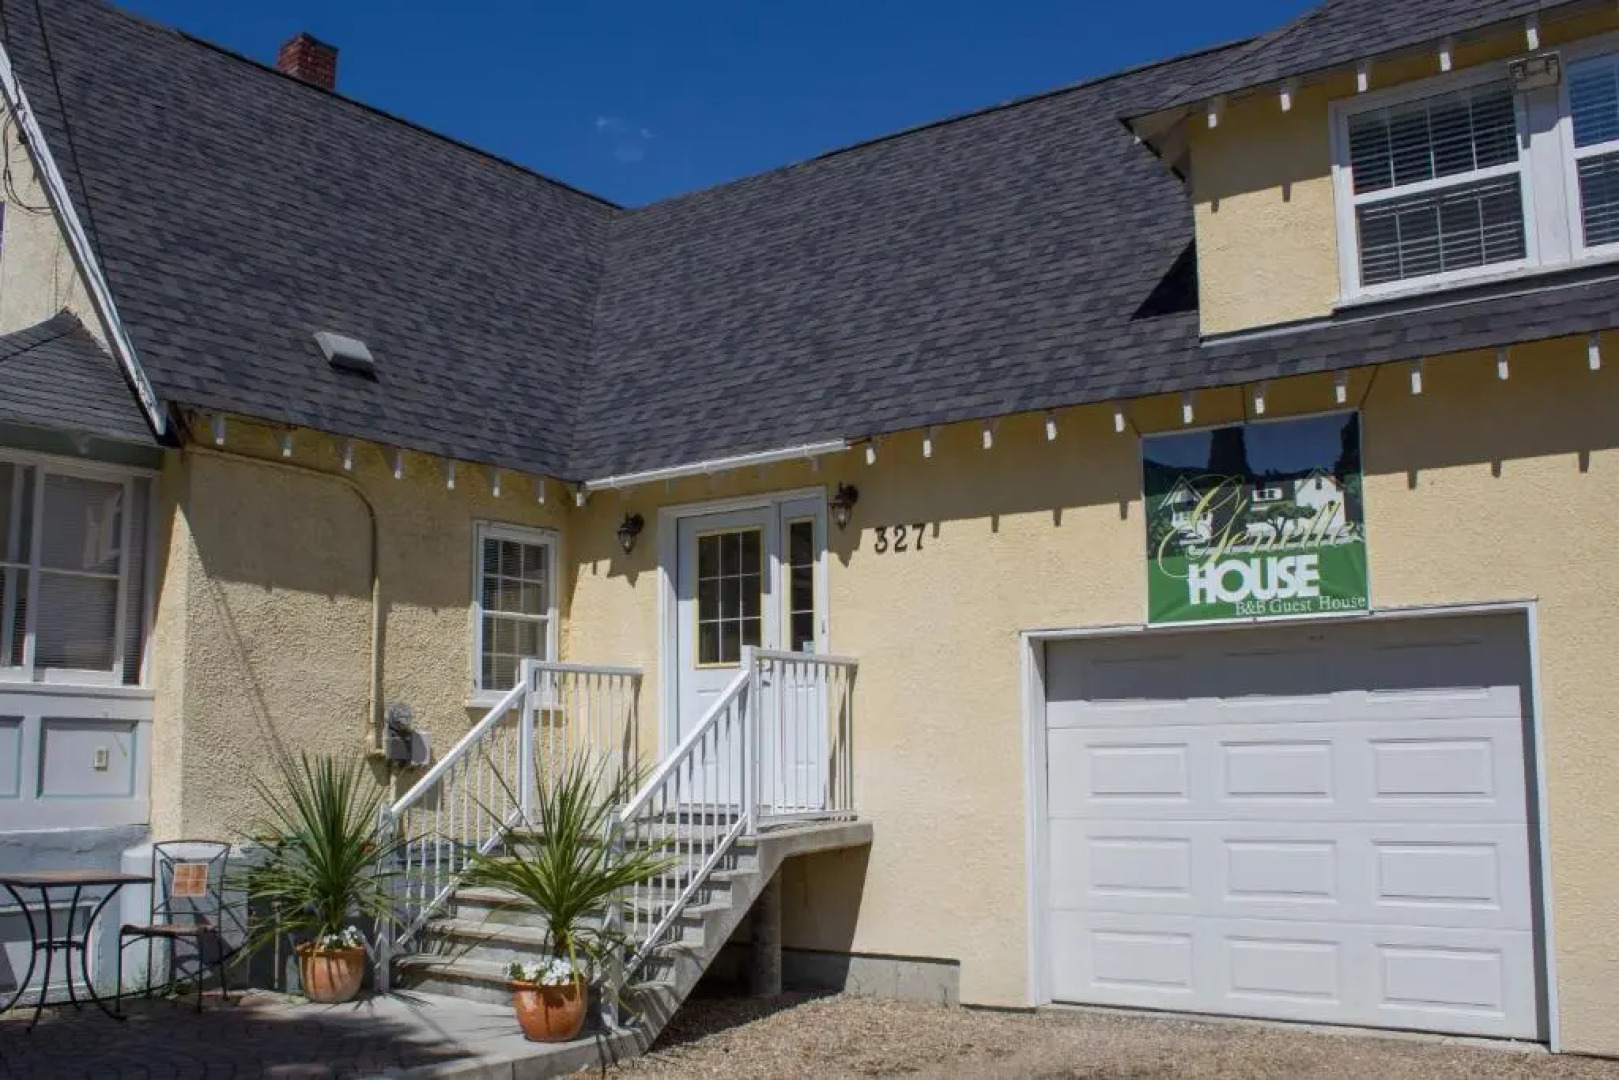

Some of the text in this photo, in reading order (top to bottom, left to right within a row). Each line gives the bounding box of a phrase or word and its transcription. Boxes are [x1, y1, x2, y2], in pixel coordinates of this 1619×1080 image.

[874, 523, 926, 554] 327
[1187, 554, 1320, 605] HOUSE
[1235, 594, 1367, 616] B&B Guest House
